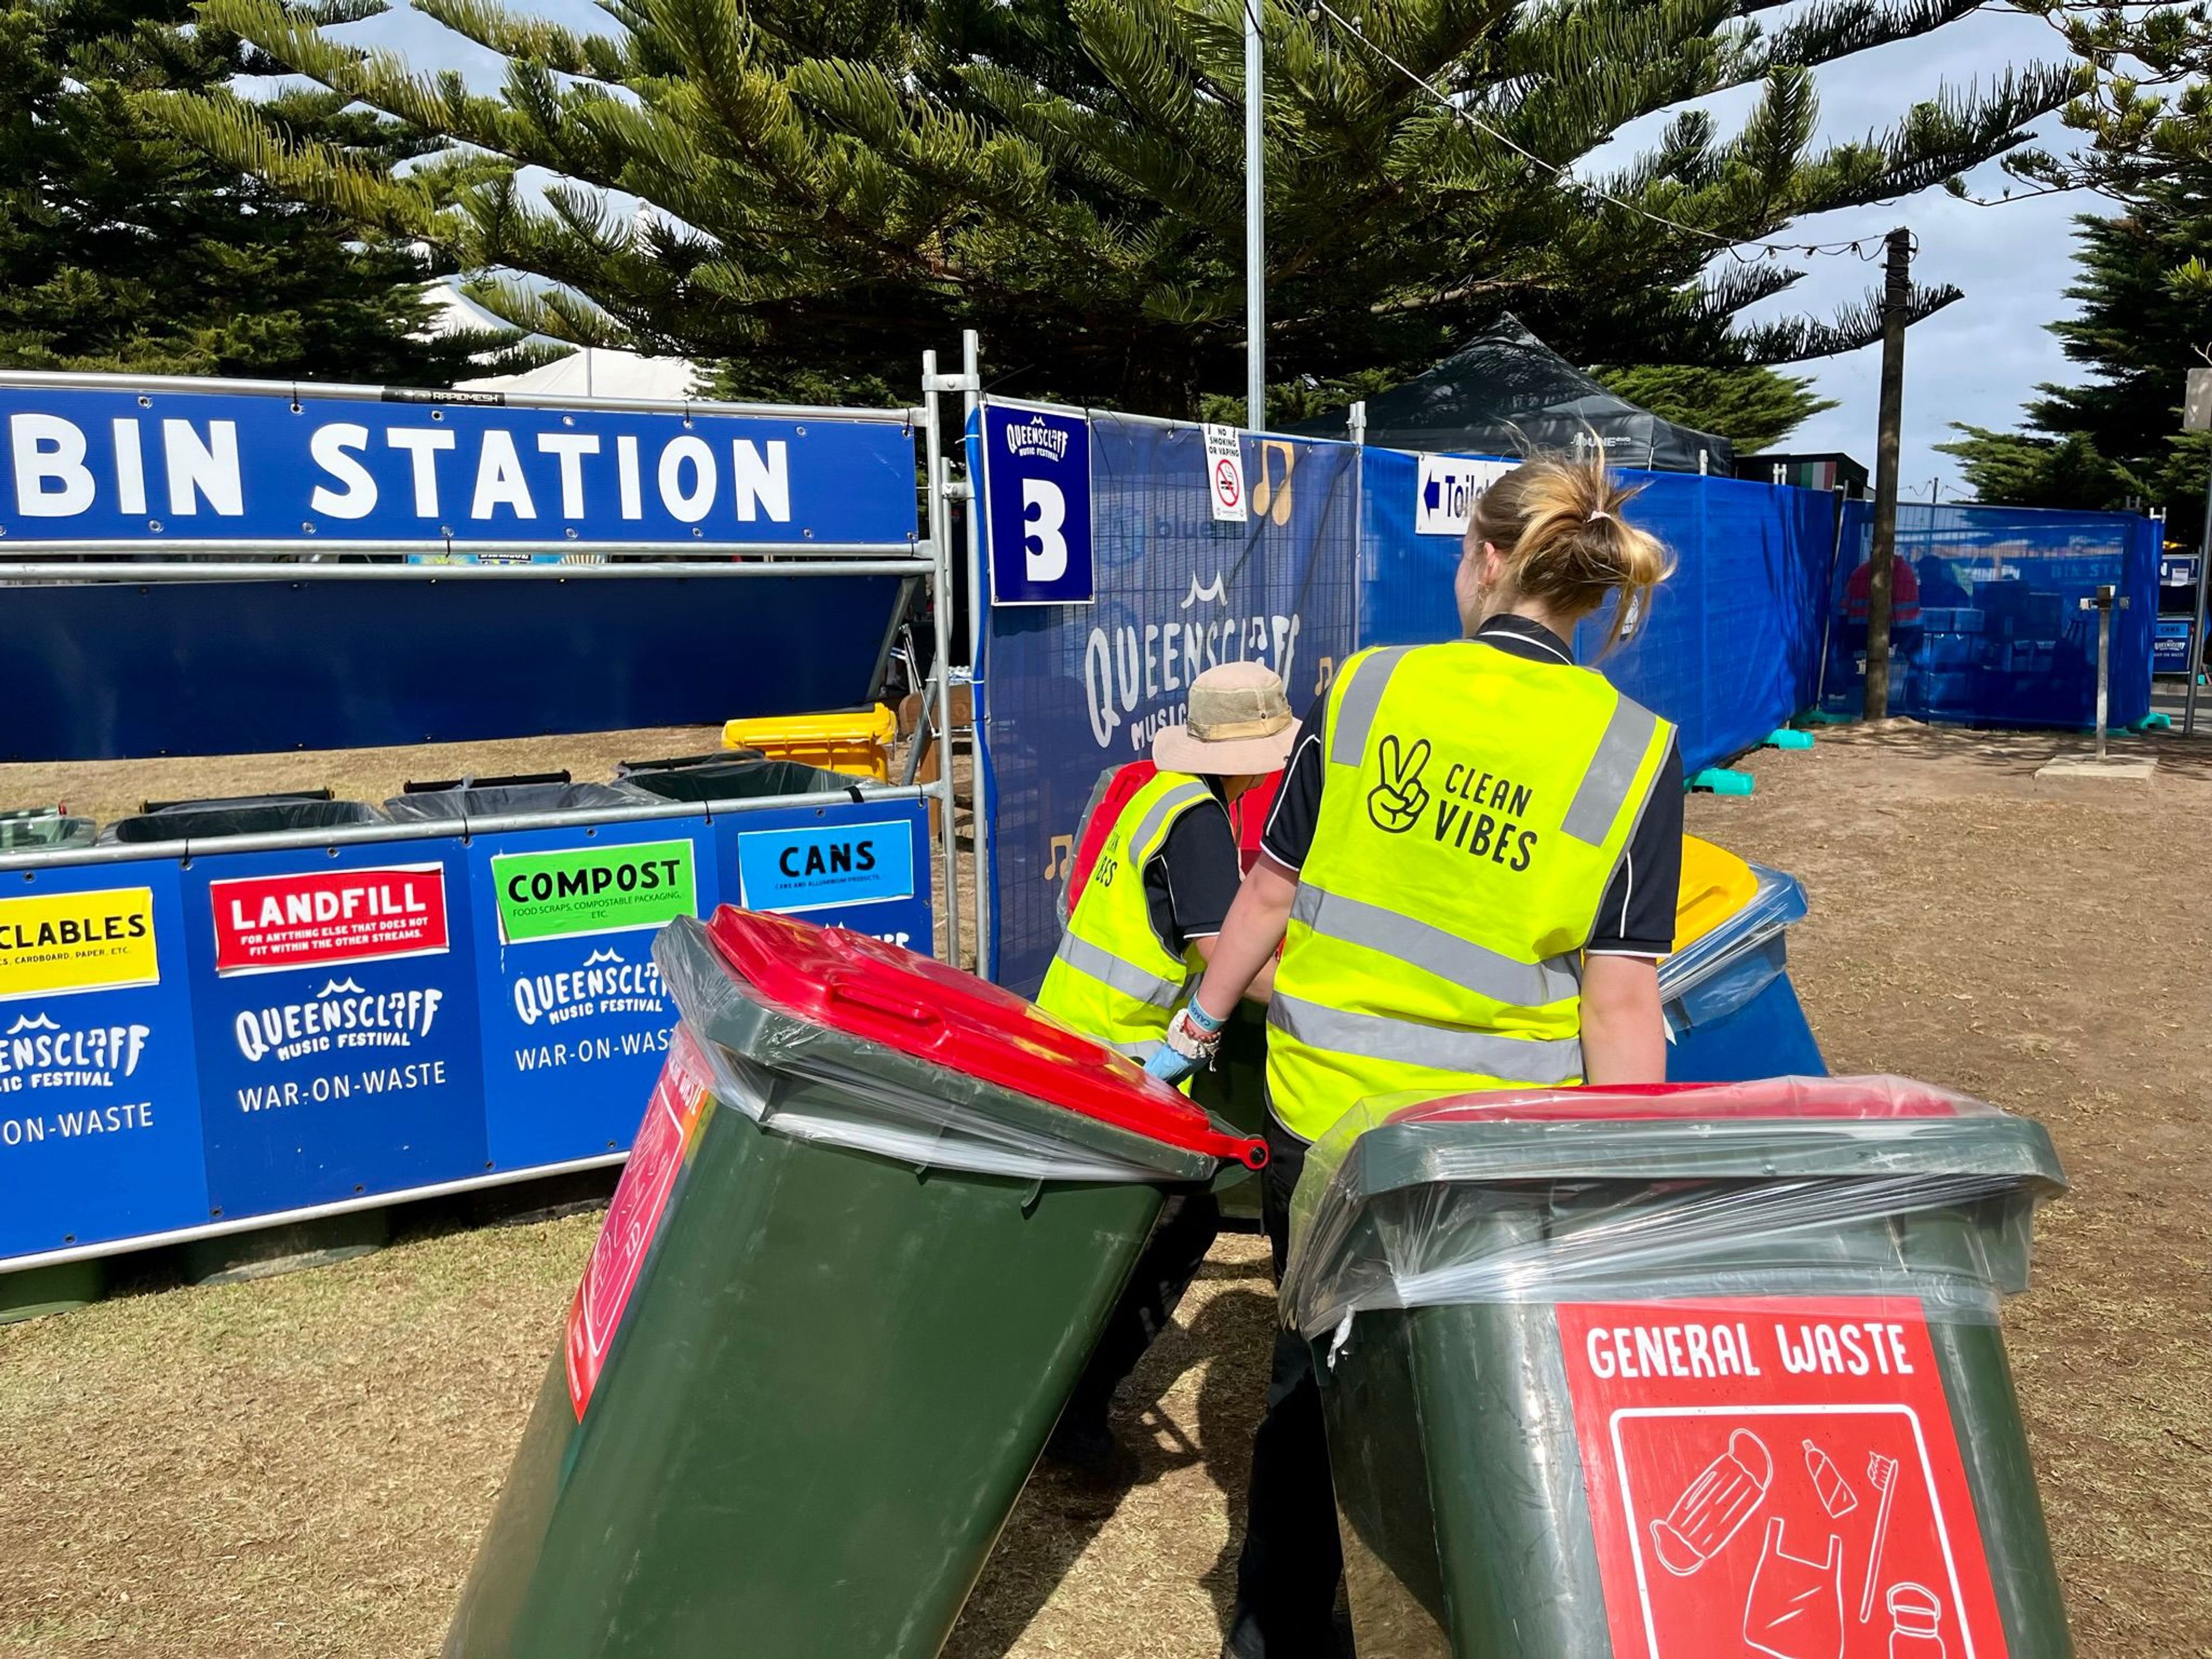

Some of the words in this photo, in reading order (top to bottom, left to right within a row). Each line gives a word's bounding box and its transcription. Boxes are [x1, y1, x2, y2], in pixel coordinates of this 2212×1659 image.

[433, 392, 498, 402] RAPIDMESH
[1006, 423, 1068, 459] QUEENSCLIFF
[1210, 436, 1236, 447] SMOKING
[1218, 427, 1226, 436] NO
[11, 413, 244, 517] BIN
[310, 422, 791, 523] STATION
[1019, 447, 1035, 456] MUSIC
[1037, 447, 1059, 461] FESTIVAL
[1218, 448, 1239, 457] VAPING
[1445, 475, 1489, 518] Toil
[1022, 478, 1068, 582] 3
[1445, 763, 1533, 817] CLEAN
[1434, 799, 1537, 872] VIBES
[779, 840, 876, 877] CANS
[508, 859, 680, 903] COMPOST
[232, 882, 426, 930] LANDFILL
[513, 908, 537, 917] FOOD
[539, 904, 573, 914] SCRAPS,
[574, 896, 632, 910] COMPOSTABLE
[634, 891, 682, 903] PACKAGING,
[241, 933, 263, 945] FOR
[266, 929, 319, 942] ANYTHING
[321, 925, 349, 936] ELSE
[351, 922, 377, 933] THAT
[380, 920, 407, 930] DOES
[409, 917, 429, 927] NOT
[249, 946, 268, 956] FIT
[271, 942, 309, 954] WITHIN
[312, 939, 333, 949] THE
[335, 935, 369, 947] OTHER
[372, 929, 423, 943] STREAMS.
[236, 988, 443, 1062] QUEENSCLIFF
[549, 1002, 593, 1025] MUSIC
[600, 999, 662, 1013] FESTIVAL
[277, 1036, 330, 1061] MUSIC
[338, 1032, 411, 1048] FESTIVAL
[516, 1028, 674, 1071] WAR-ON-WAS
[31, 1071, 113, 1088] FESTIVAL
[238, 1060, 446, 1113] WAR-ON-WASTE
[1586, 1323, 1761, 1379] GENERAL
[1777, 1323, 1914, 1376] WASTE
